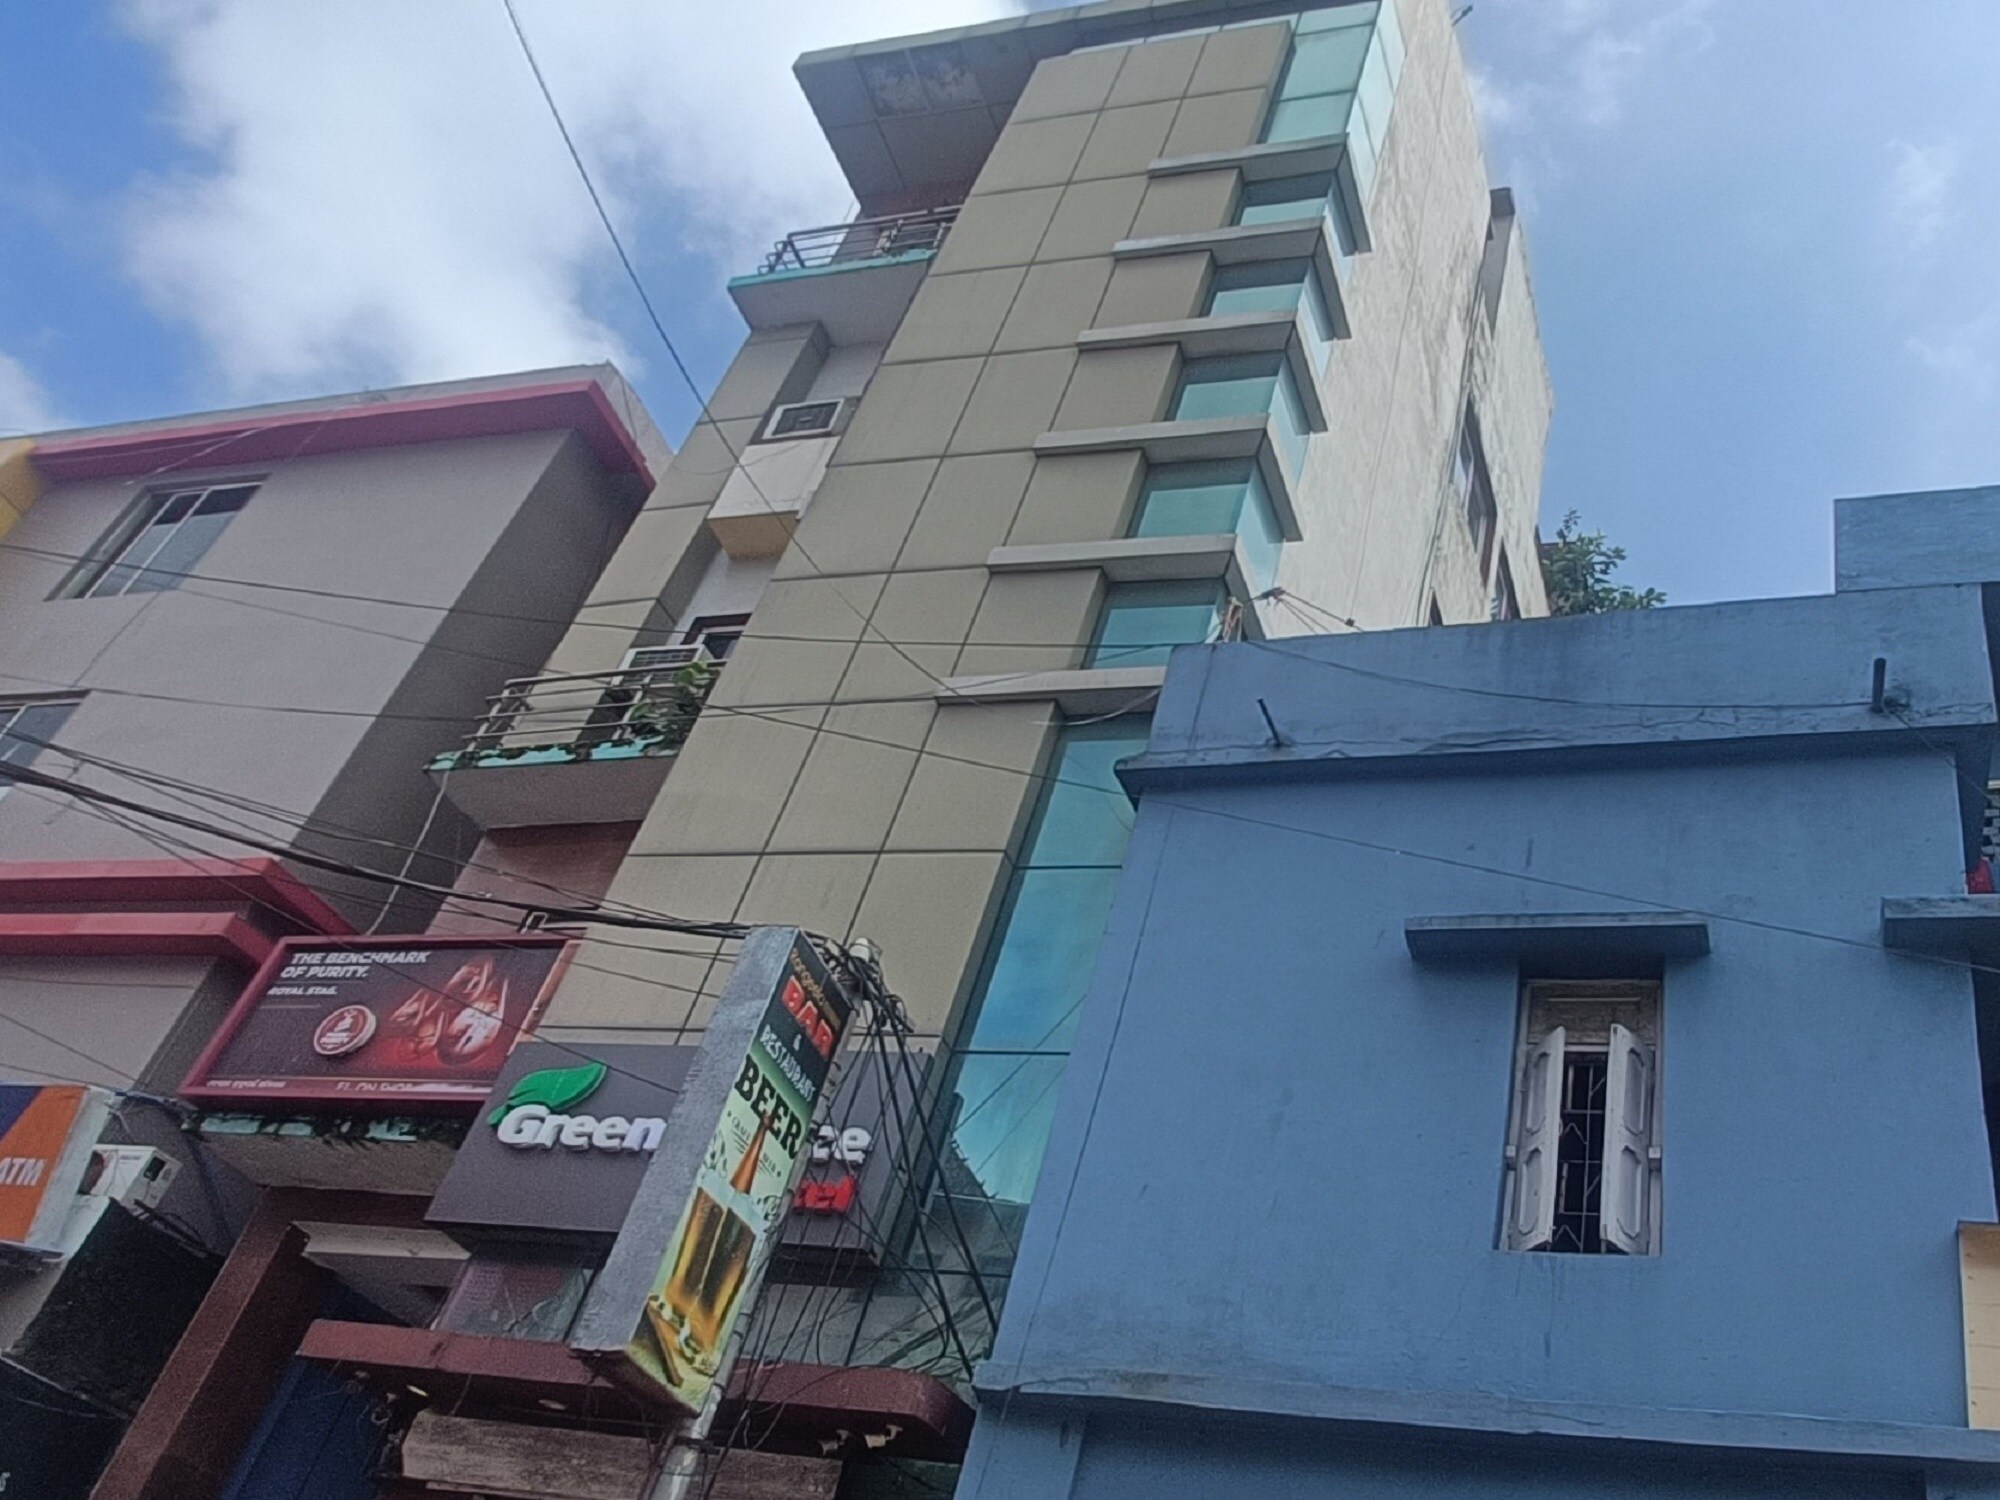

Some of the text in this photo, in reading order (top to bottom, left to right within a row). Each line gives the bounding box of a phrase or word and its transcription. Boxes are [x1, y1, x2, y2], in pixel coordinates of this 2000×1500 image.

[280, 965, 370, 978] OF PURITY.
[291, 951, 431, 964] THE BENCHMARK
[734, 1053, 802, 1159] BEER
[497, 1103, 667, 1152] Green
